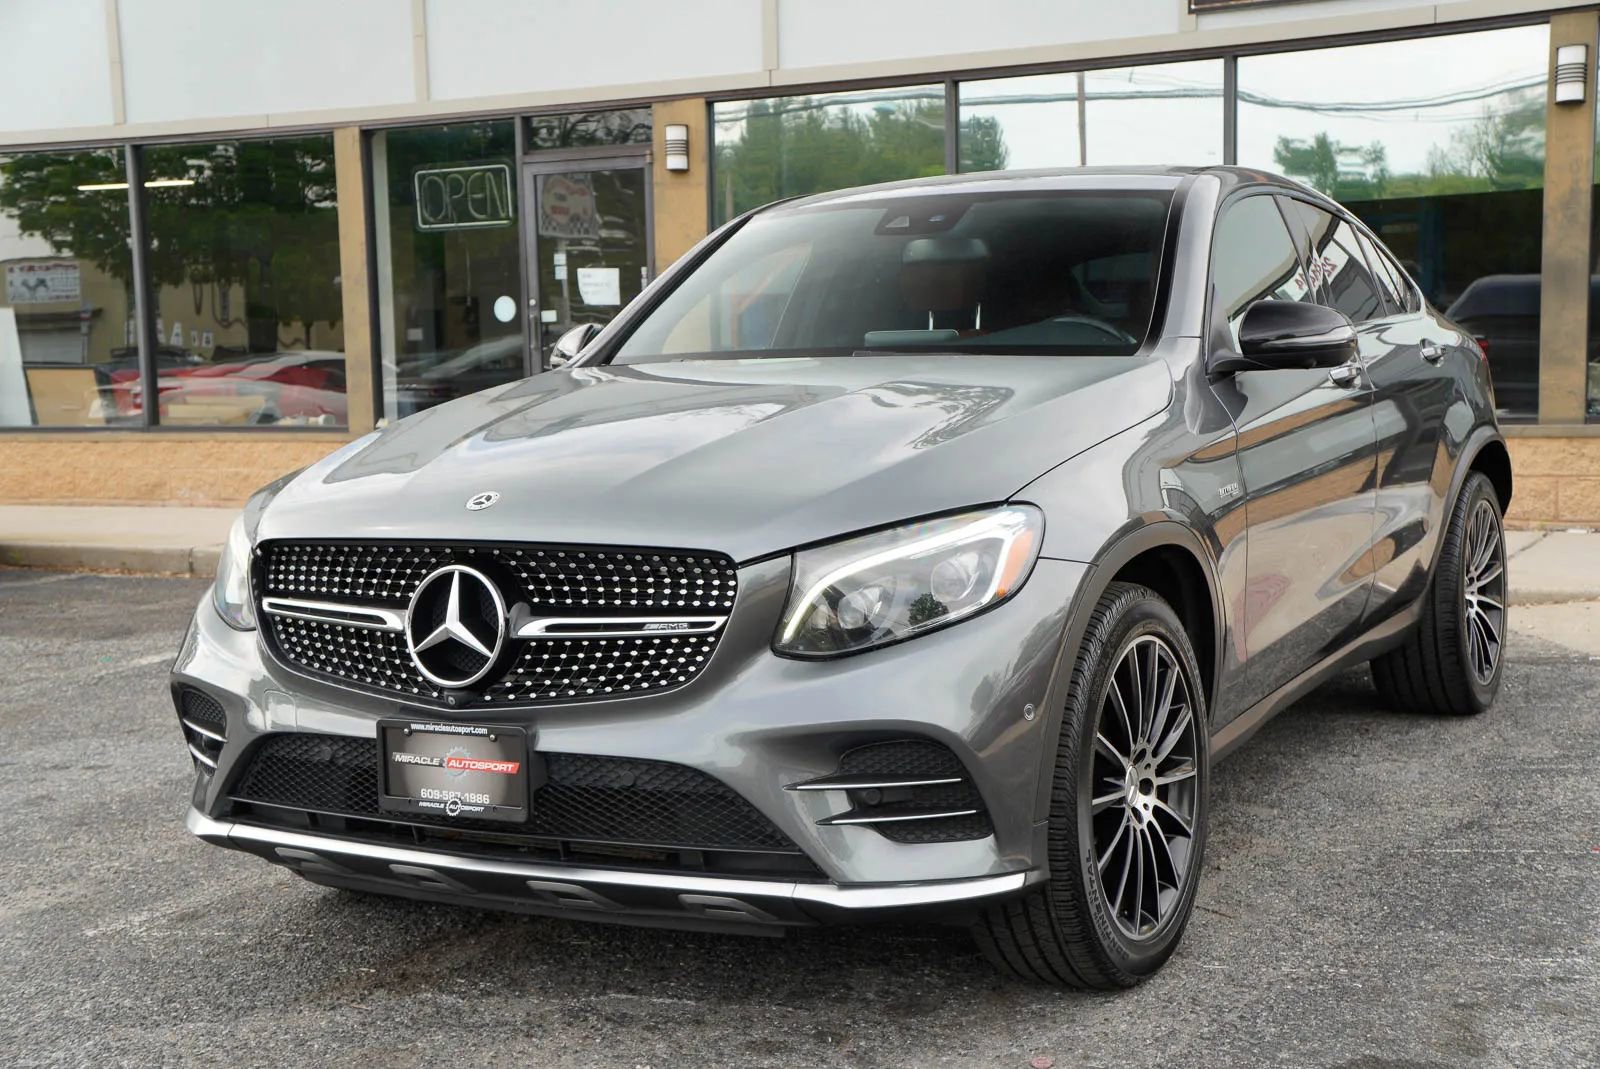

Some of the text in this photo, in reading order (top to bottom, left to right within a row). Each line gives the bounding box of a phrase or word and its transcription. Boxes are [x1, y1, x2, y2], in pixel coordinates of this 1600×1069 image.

[421, 171, 507, 223] OPEN
[411, 722, 488, 735] www.miracleautosport.com
[395, 754, 515, 772] MIRACLE AUTOSPORT
[418, 801, 445, 809] MIRACLE
